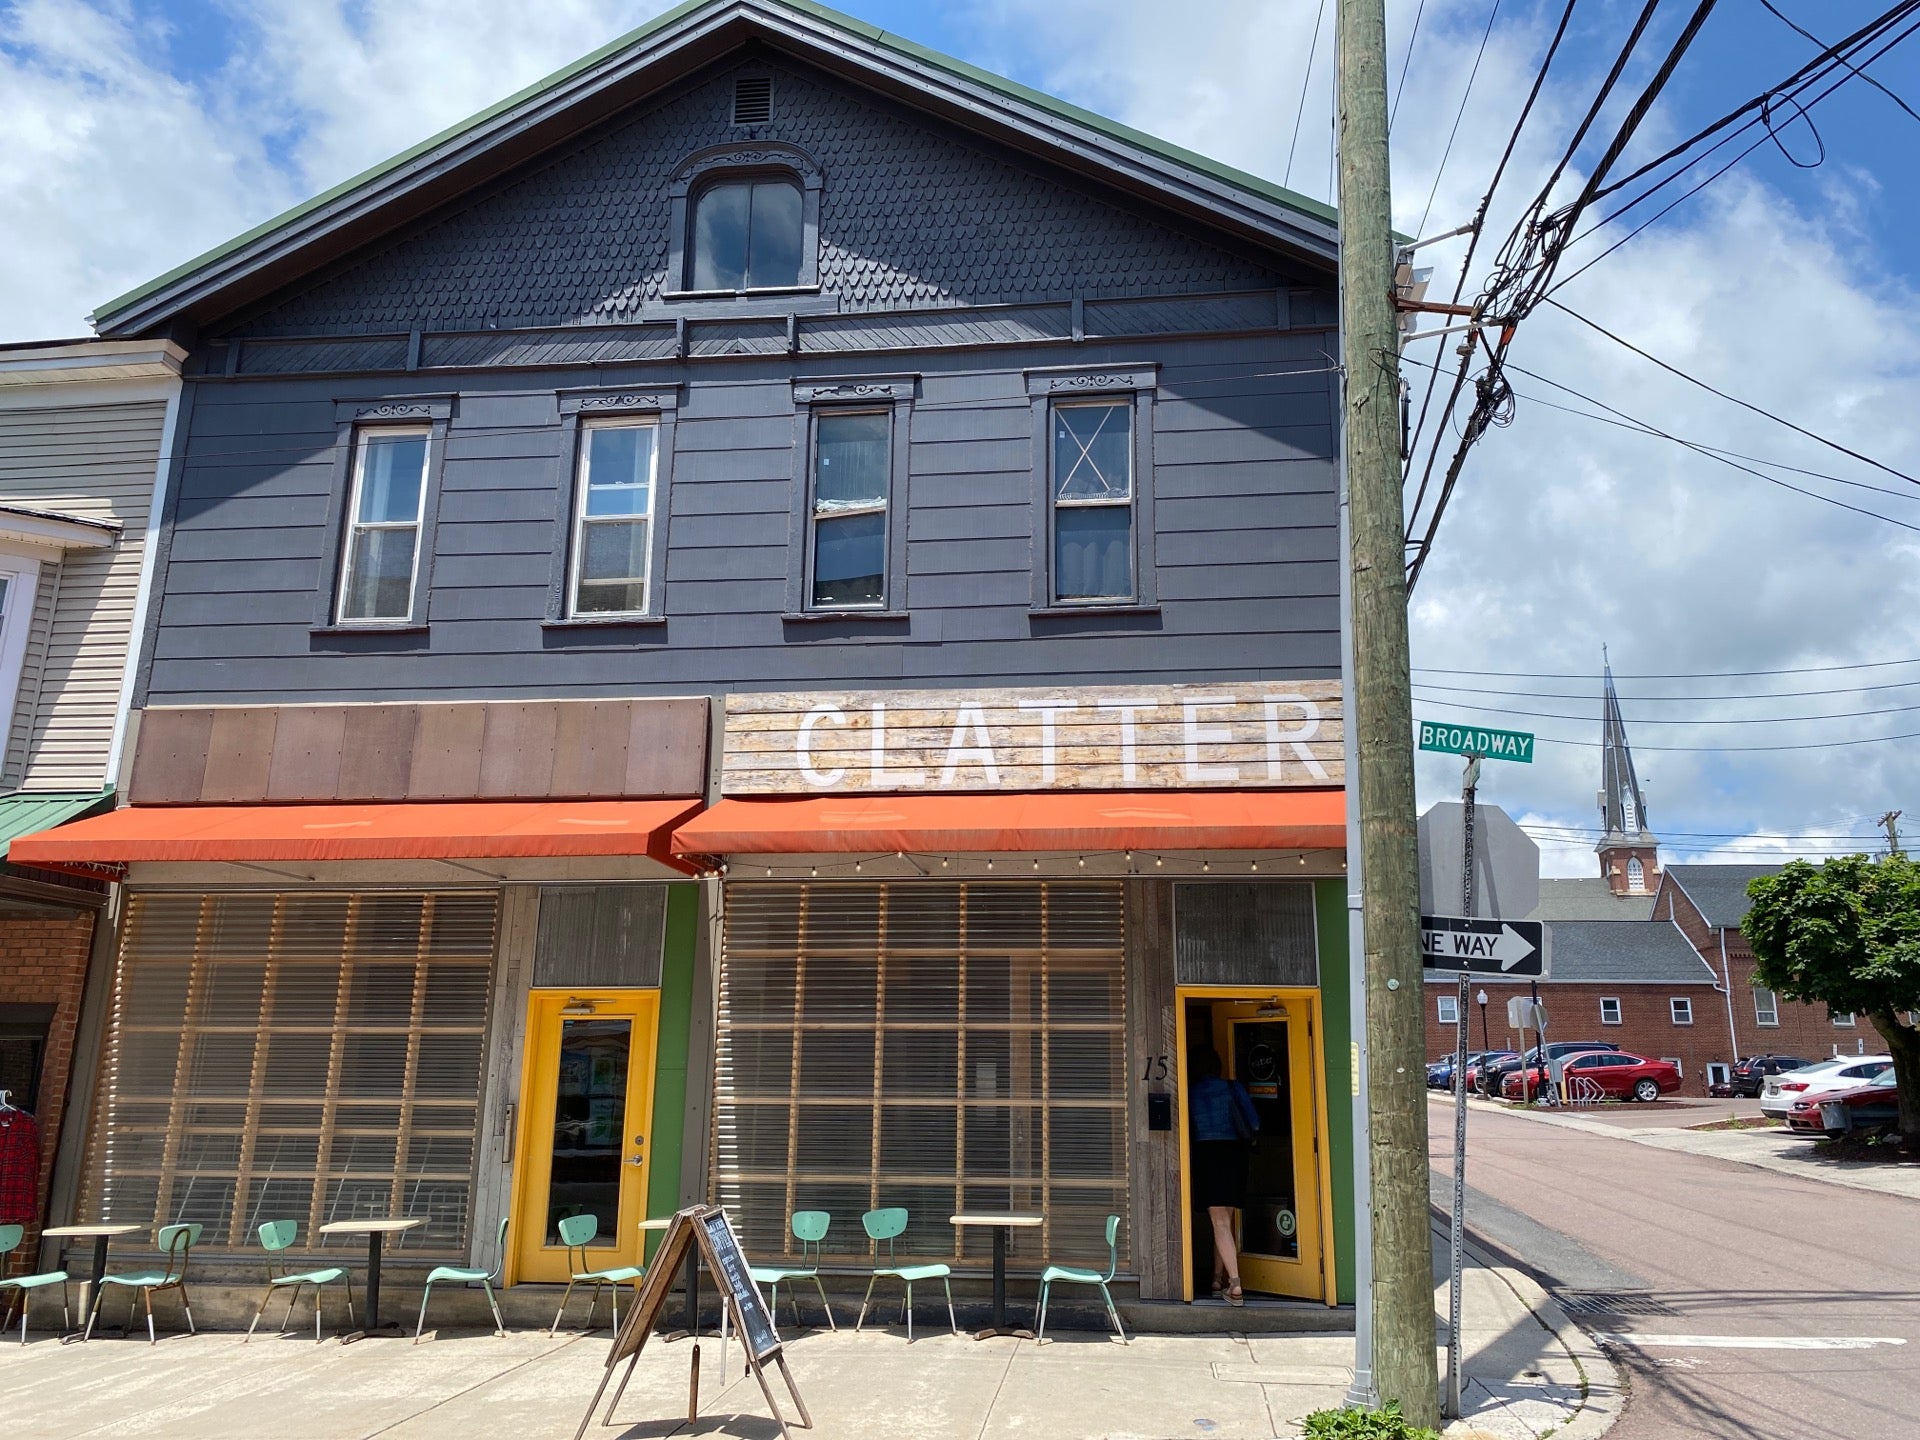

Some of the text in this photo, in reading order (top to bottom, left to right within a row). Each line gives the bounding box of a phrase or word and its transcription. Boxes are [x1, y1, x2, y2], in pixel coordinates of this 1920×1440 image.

[796, 694, 1330, 787] CLATTER
[1421, 726, 1530, 756] BROADWAY
[1421, 932, 1498, 957] NE WAY
[1141, 1055, 1168, 1081] 15
